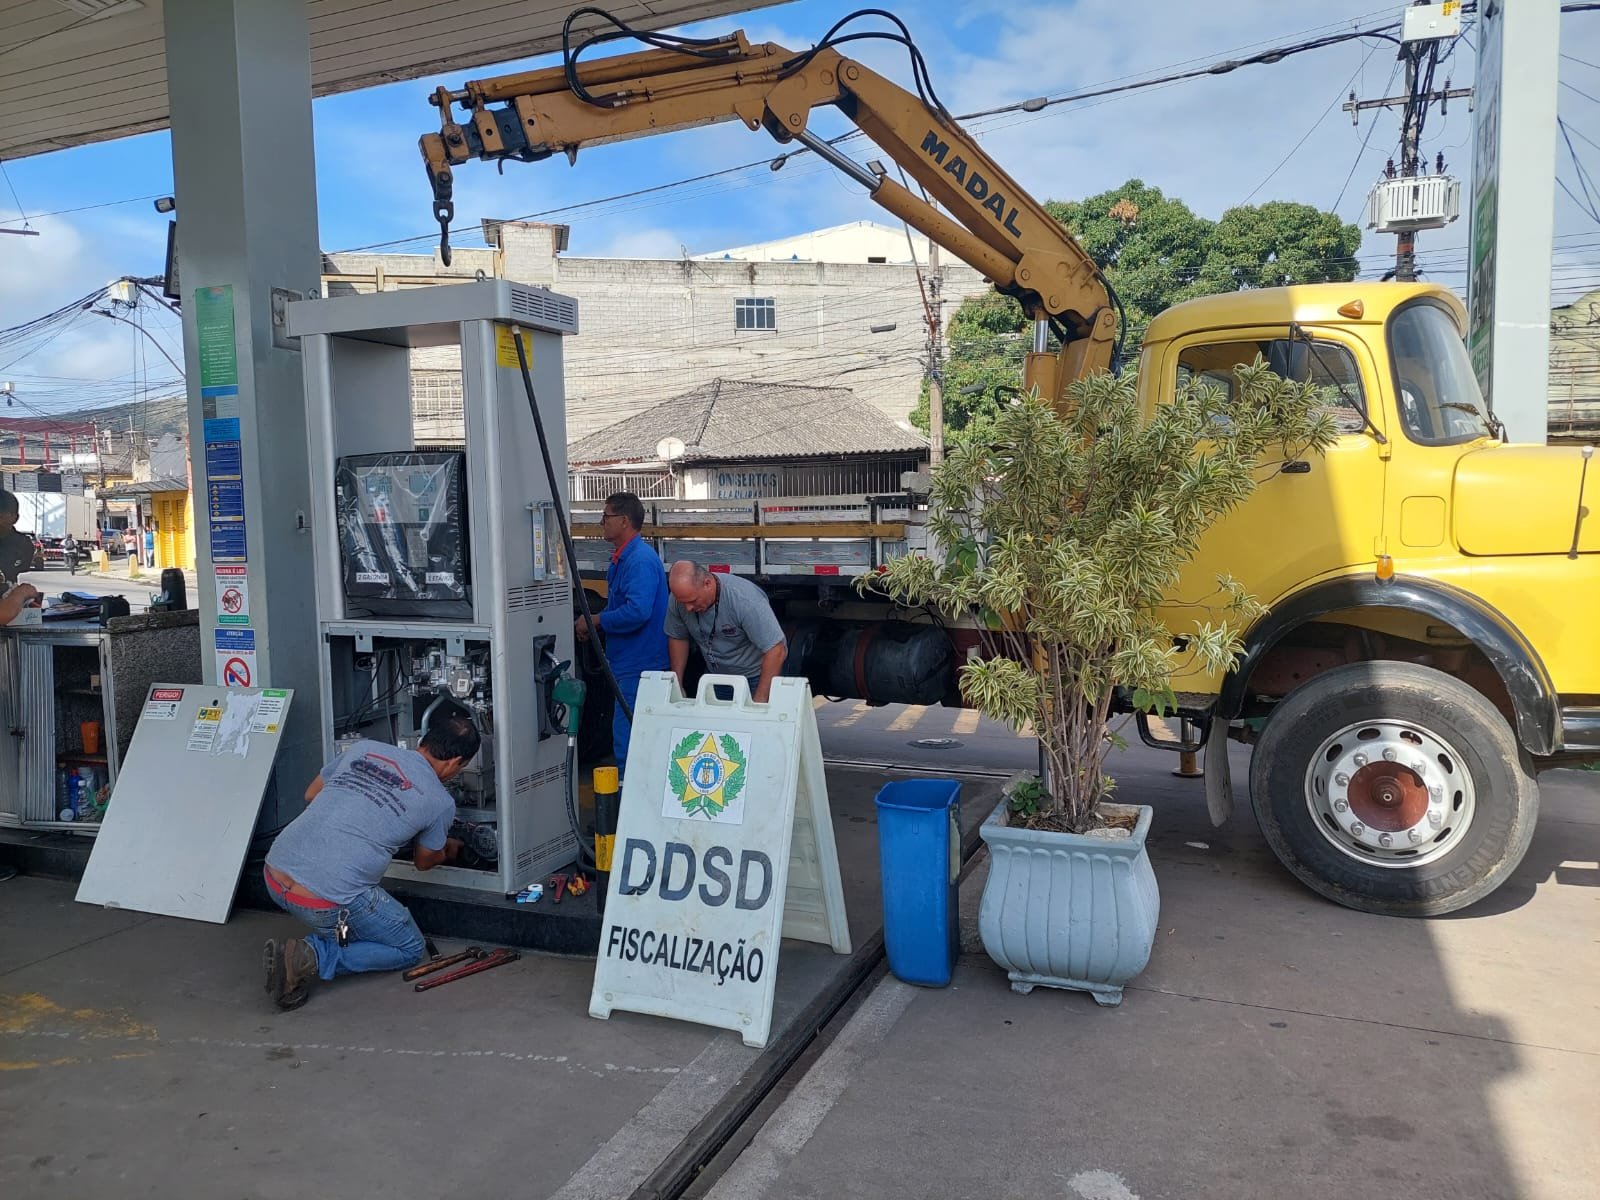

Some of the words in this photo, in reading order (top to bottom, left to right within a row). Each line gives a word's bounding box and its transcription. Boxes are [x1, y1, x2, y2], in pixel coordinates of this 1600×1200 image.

[921, 130, 1022, 239] MADAL
[619, 838, 773, 910] DDSD
[607, 925, 764, 986] FISCALIZAÇÃO
